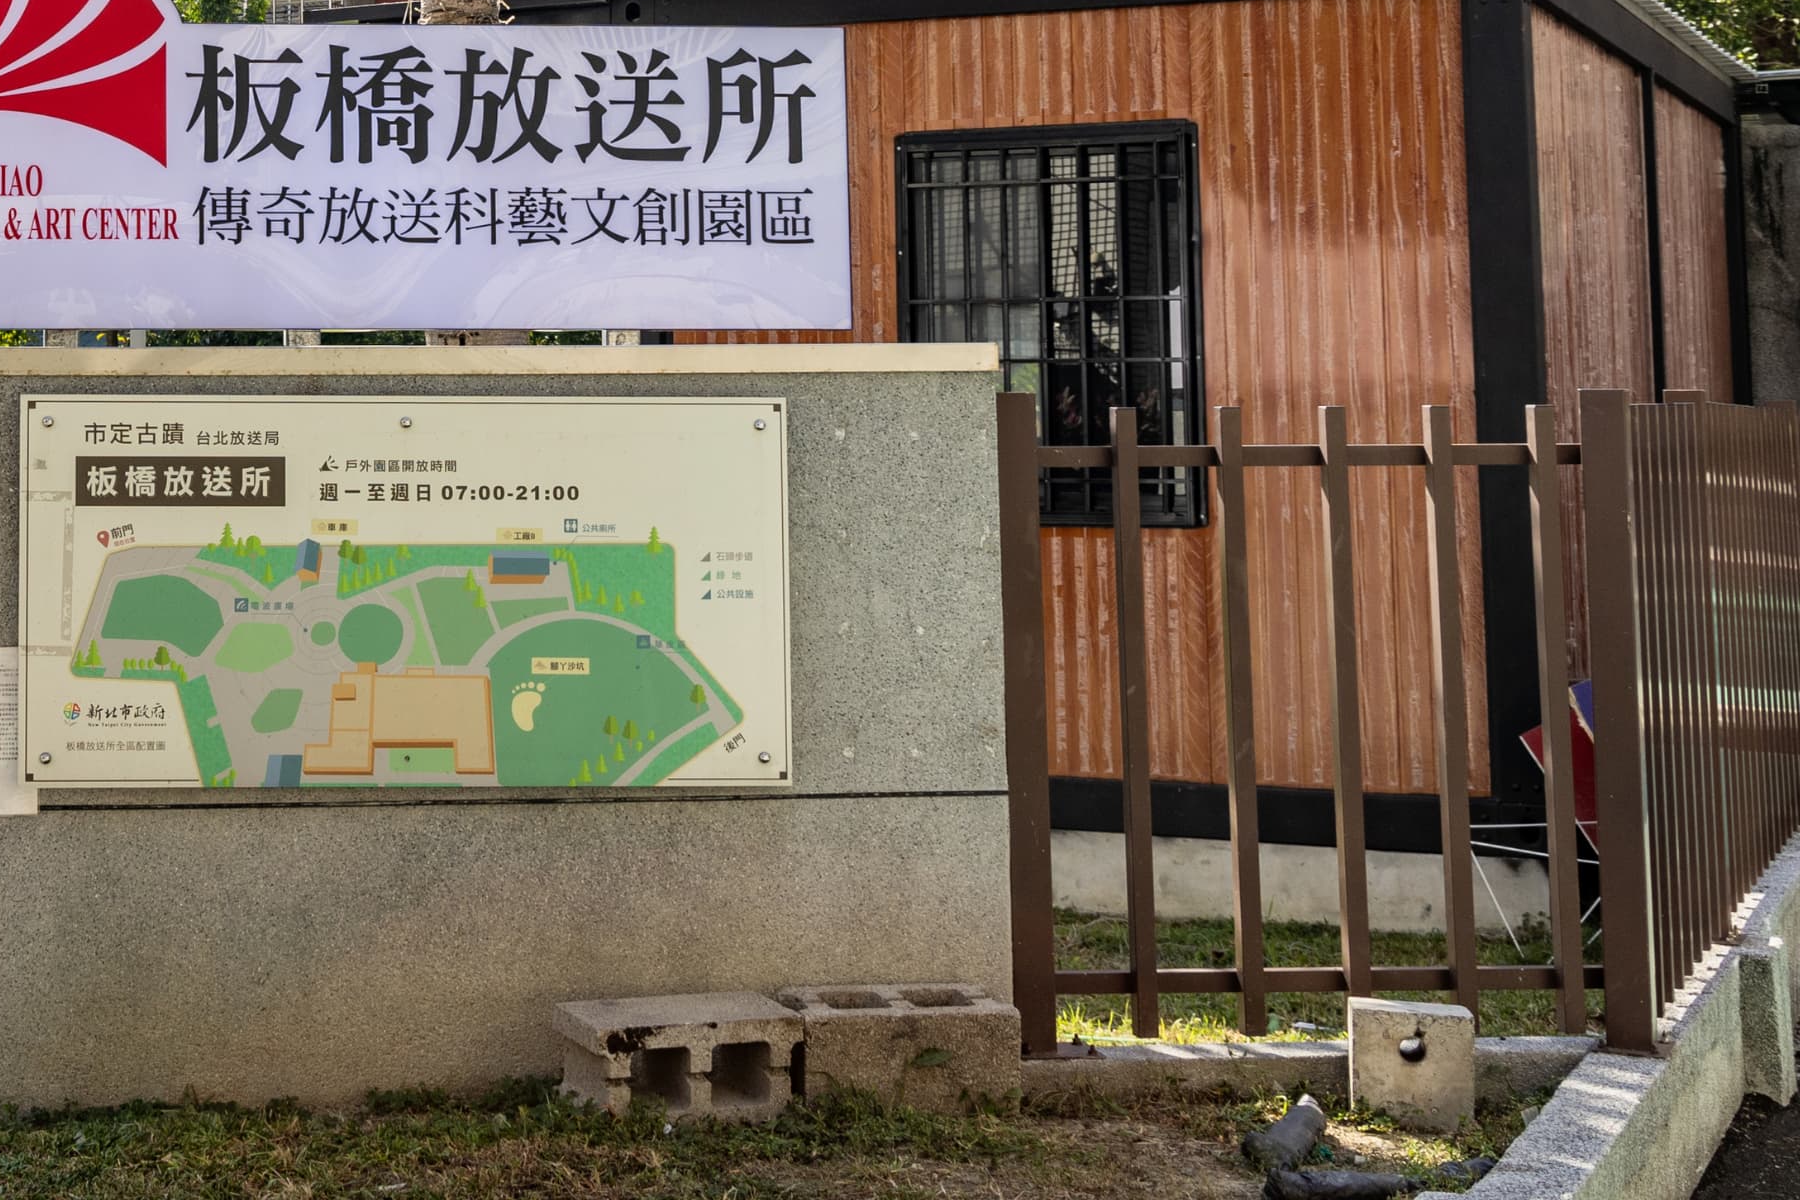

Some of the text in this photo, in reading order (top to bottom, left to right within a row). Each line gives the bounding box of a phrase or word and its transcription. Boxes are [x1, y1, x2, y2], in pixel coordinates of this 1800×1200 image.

[185, 44, 817, 165] 板橋放送所
[3, 208, 23, 241] &
[28, 207, 76, 240] ART
[82, 207, 180, 241] CENTER
[191, 185, 816, 248] 傳奇放送科藝文創園區
[84, 422, 280, 446] 市定古蹟 台北放送局
[86, 465, 271, 497] 板橋放送所
[319, 483, 580, 502] 週一至週日 07:00-21:00
[110, 523, 135, 539] 前門
[86, 702, 166, 721] 新北市政府
[723, 732, 746, 753] 後門
